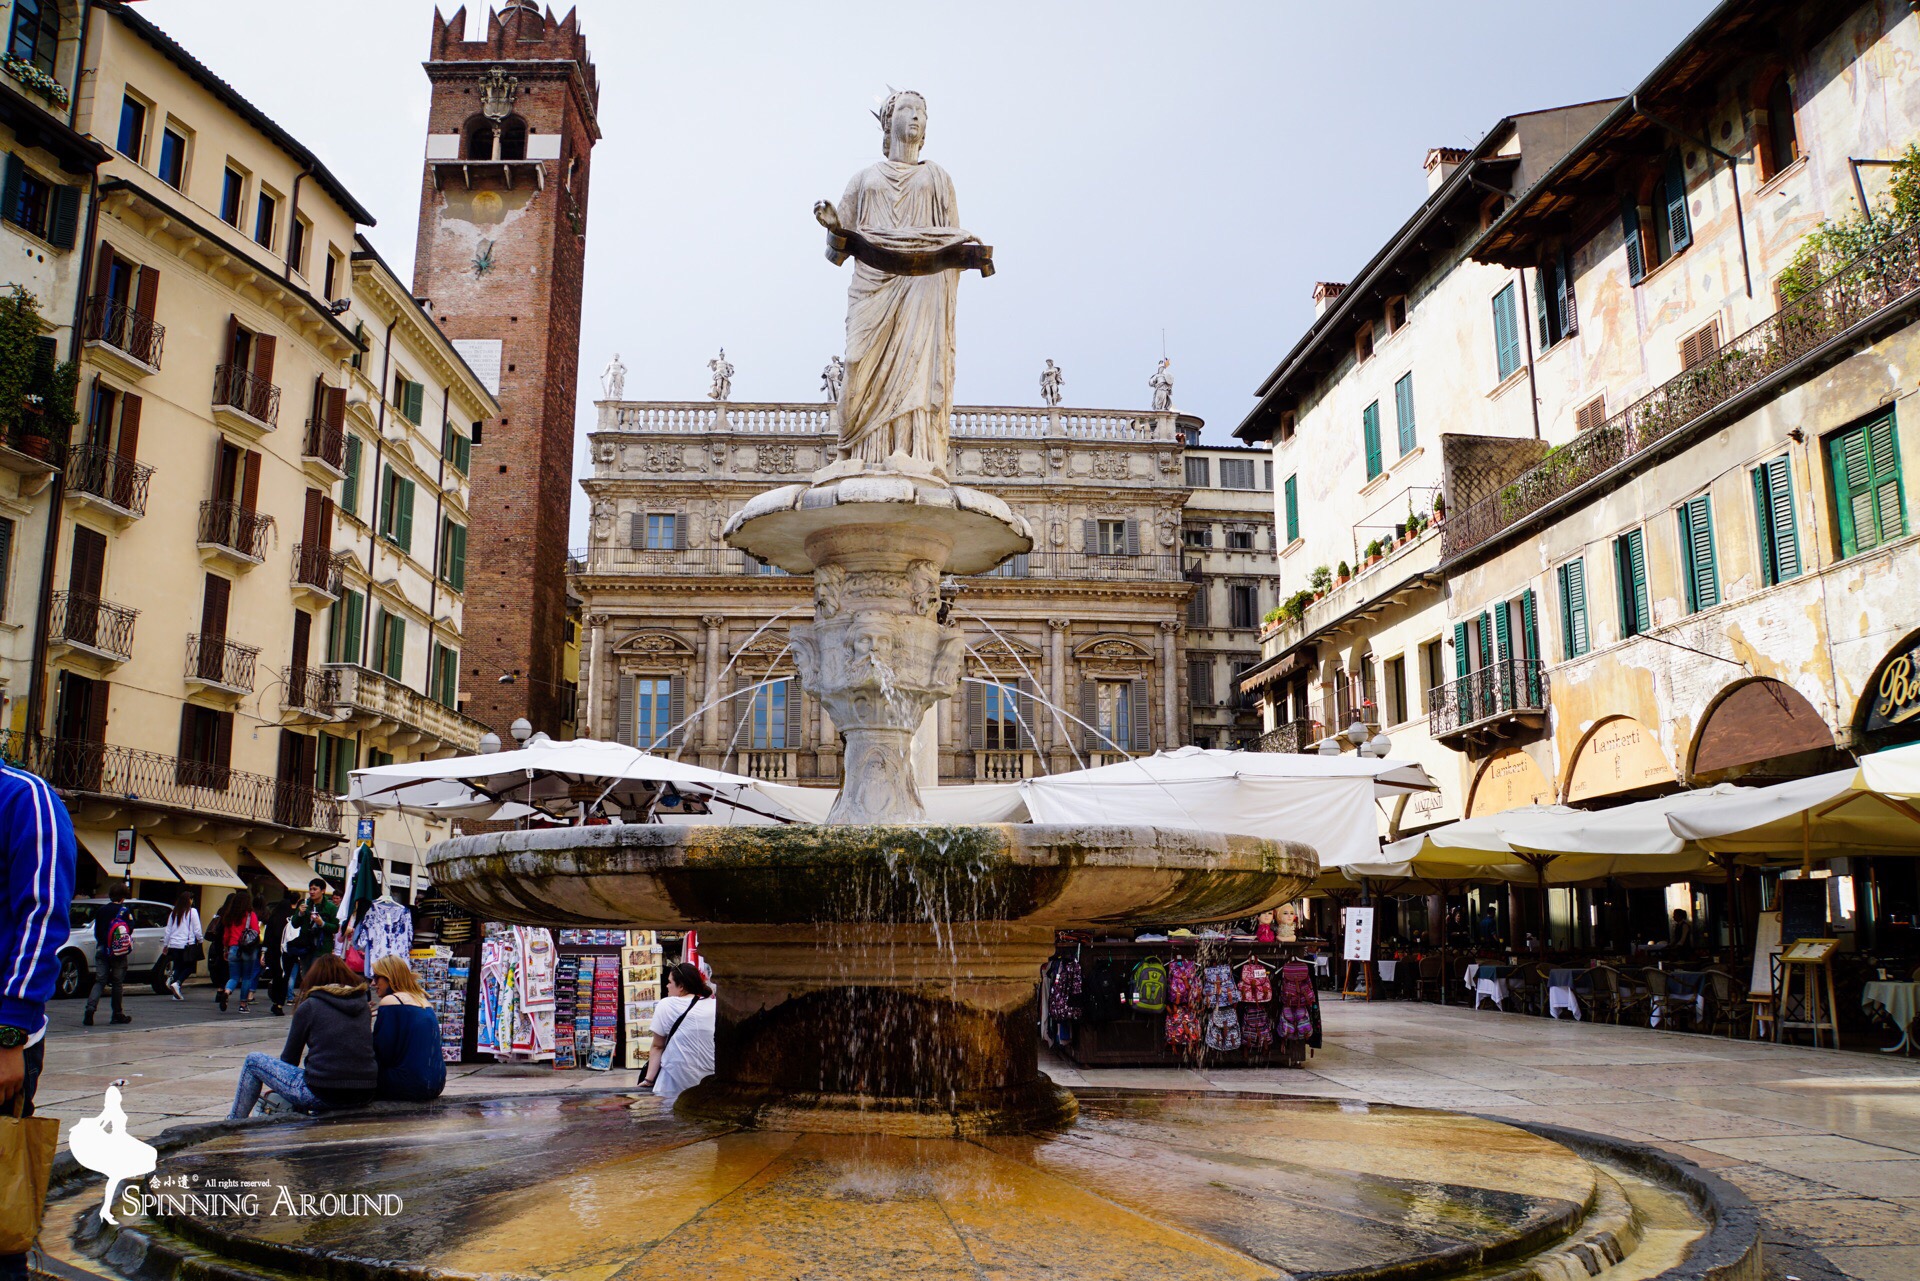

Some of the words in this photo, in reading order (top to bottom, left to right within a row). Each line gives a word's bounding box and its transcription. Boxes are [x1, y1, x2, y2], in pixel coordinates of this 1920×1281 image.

[1879, 653, 1920, 716] Bo
[1593, 728, 1640, 754] Lamberti
[1491, 758, 1527, 779] Lamberti
[179, 865, 208, 876] CINZIA
[205, 868, 234, 879] ROCCA
[317, 863, 345, 879] TABACCHI
